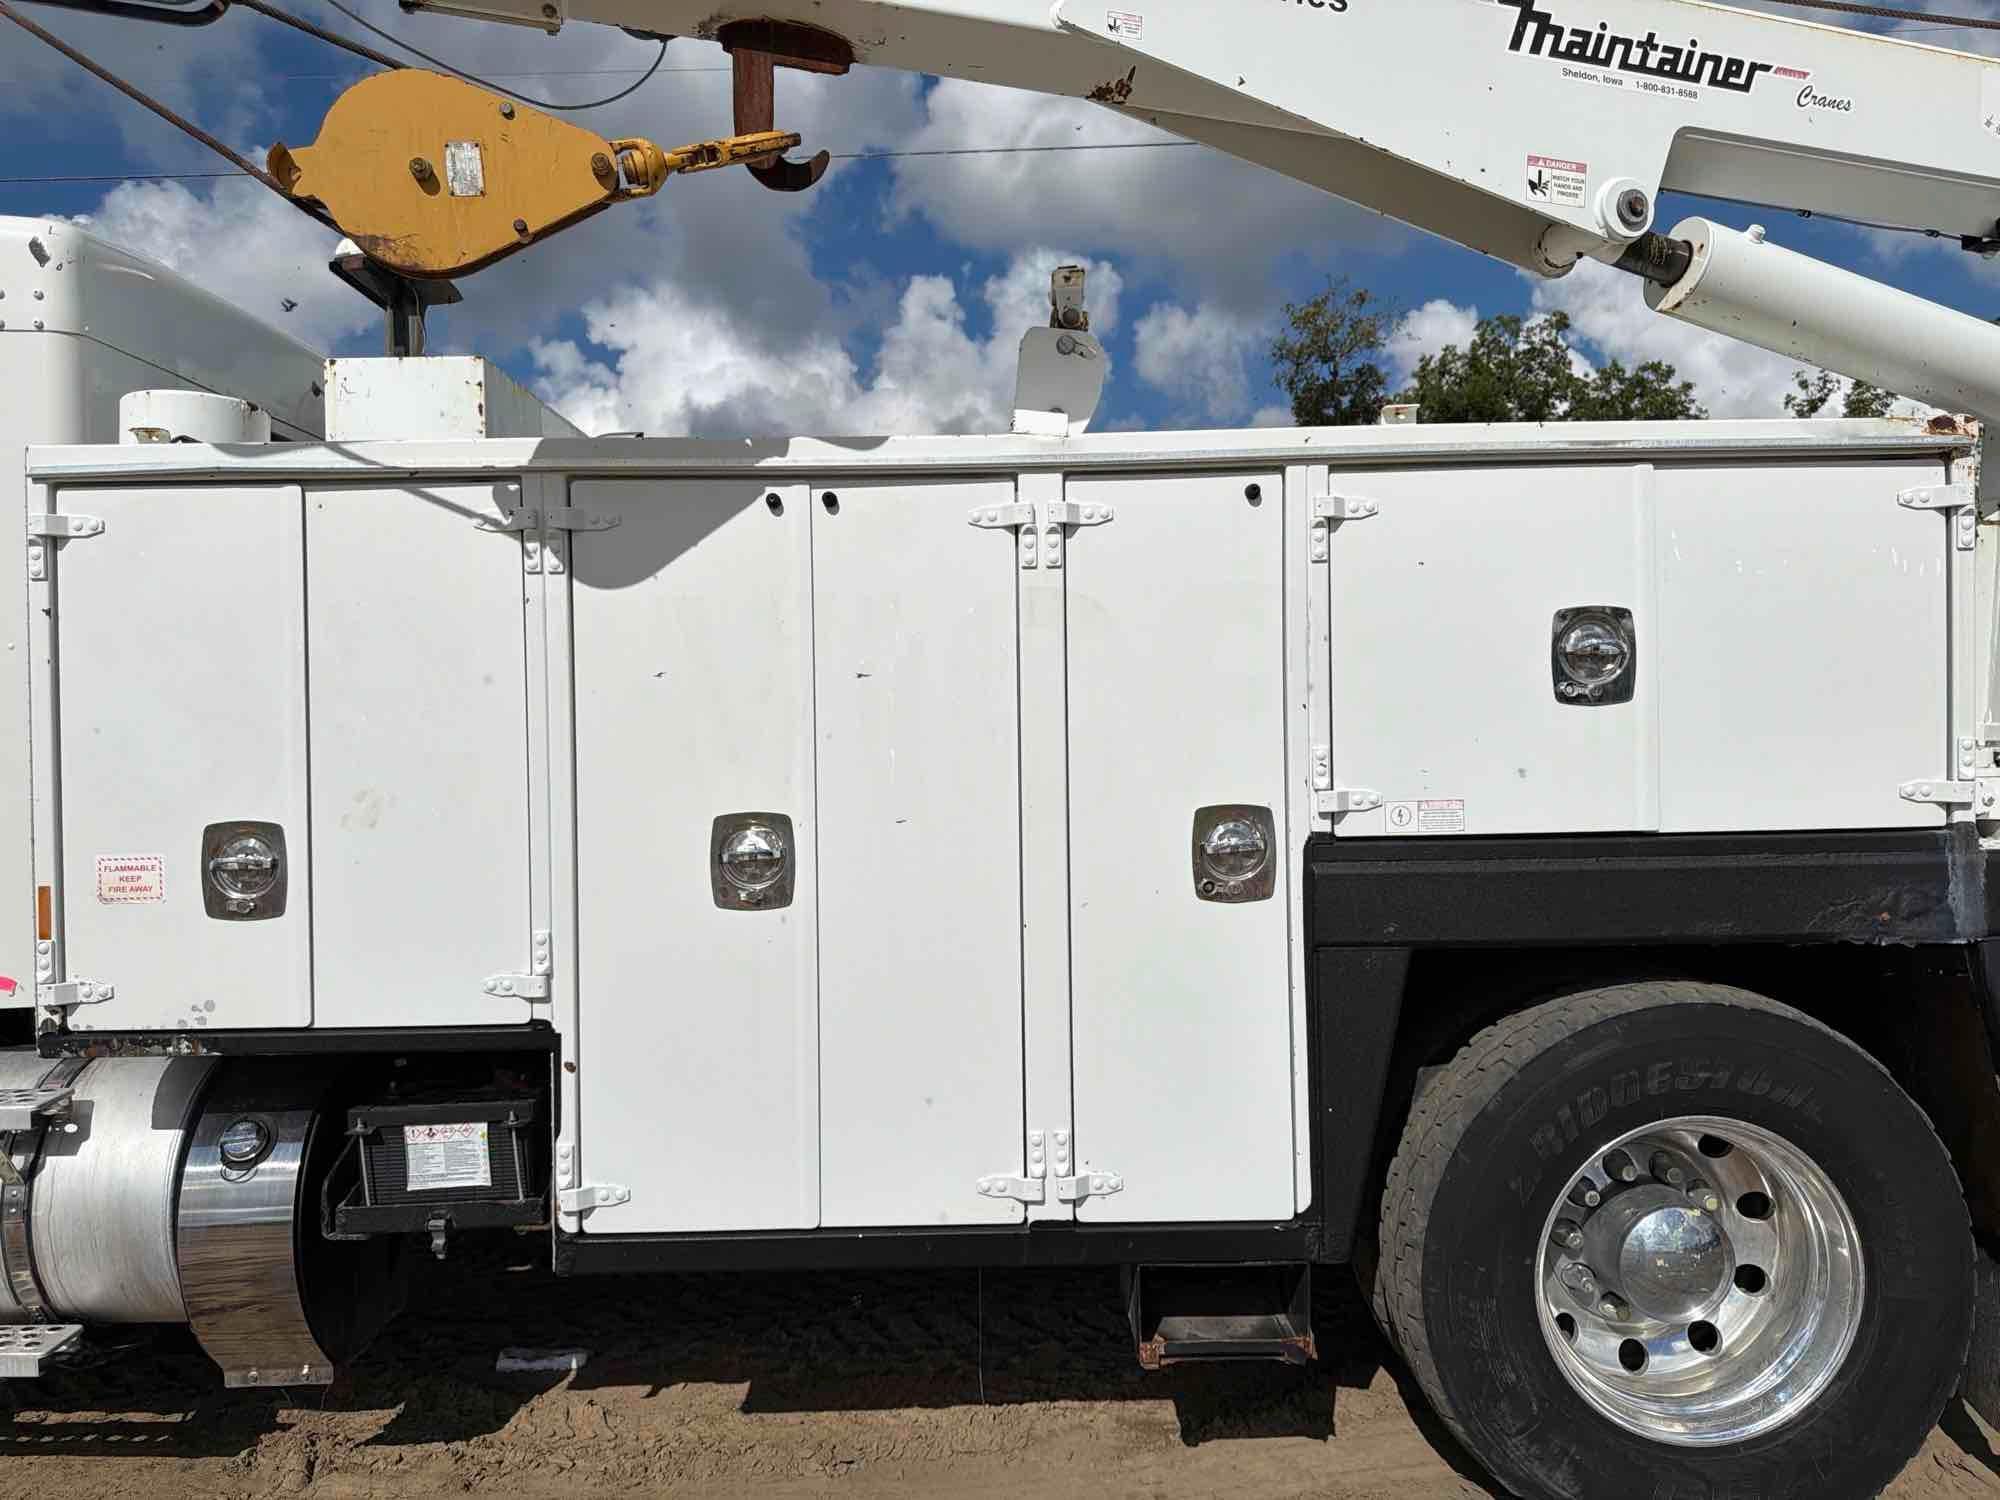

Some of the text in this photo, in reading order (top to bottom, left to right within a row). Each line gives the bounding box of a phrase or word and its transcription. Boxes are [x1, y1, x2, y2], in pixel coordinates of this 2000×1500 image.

[1497, 0, 1773, 93] Maintainer
[1561, 67, 1600, 82] Sheldon,
[1603, 74, 1623, 86] Iowa
[1797, 85, 1852, 112] Cranes
[1546, 160, 1577, 170] DANGER
[1553, 183, 1571, 191] HANDS
[103, 864, 157, 873] FLAMMABLE
[129, 885, 153, 893] AWAY
